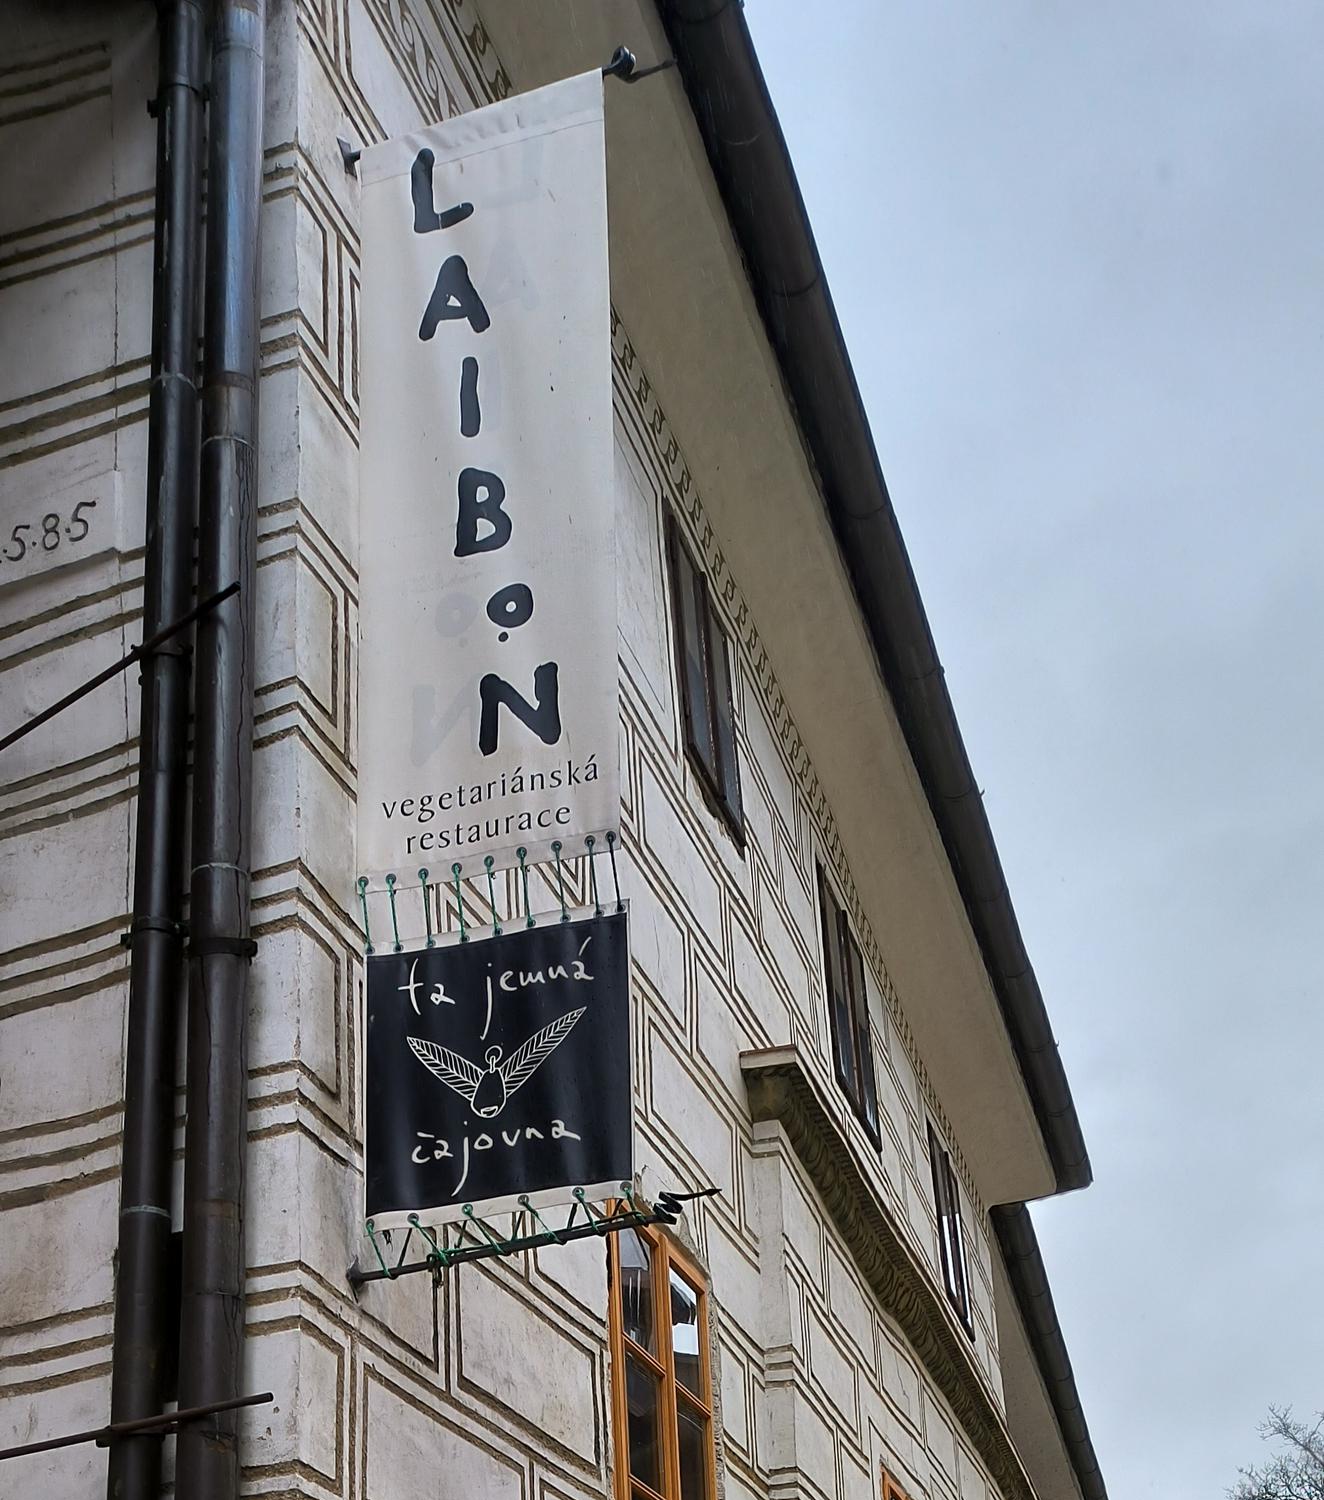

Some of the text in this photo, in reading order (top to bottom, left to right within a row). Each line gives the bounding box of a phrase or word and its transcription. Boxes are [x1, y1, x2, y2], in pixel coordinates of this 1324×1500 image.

[382, 753, 599, 823] vegetariánská
[406, 806, 571, 854] restaurace
[480, 936, 595, 1040] jemná
[411, 1119, 581, 1197] čajovna
